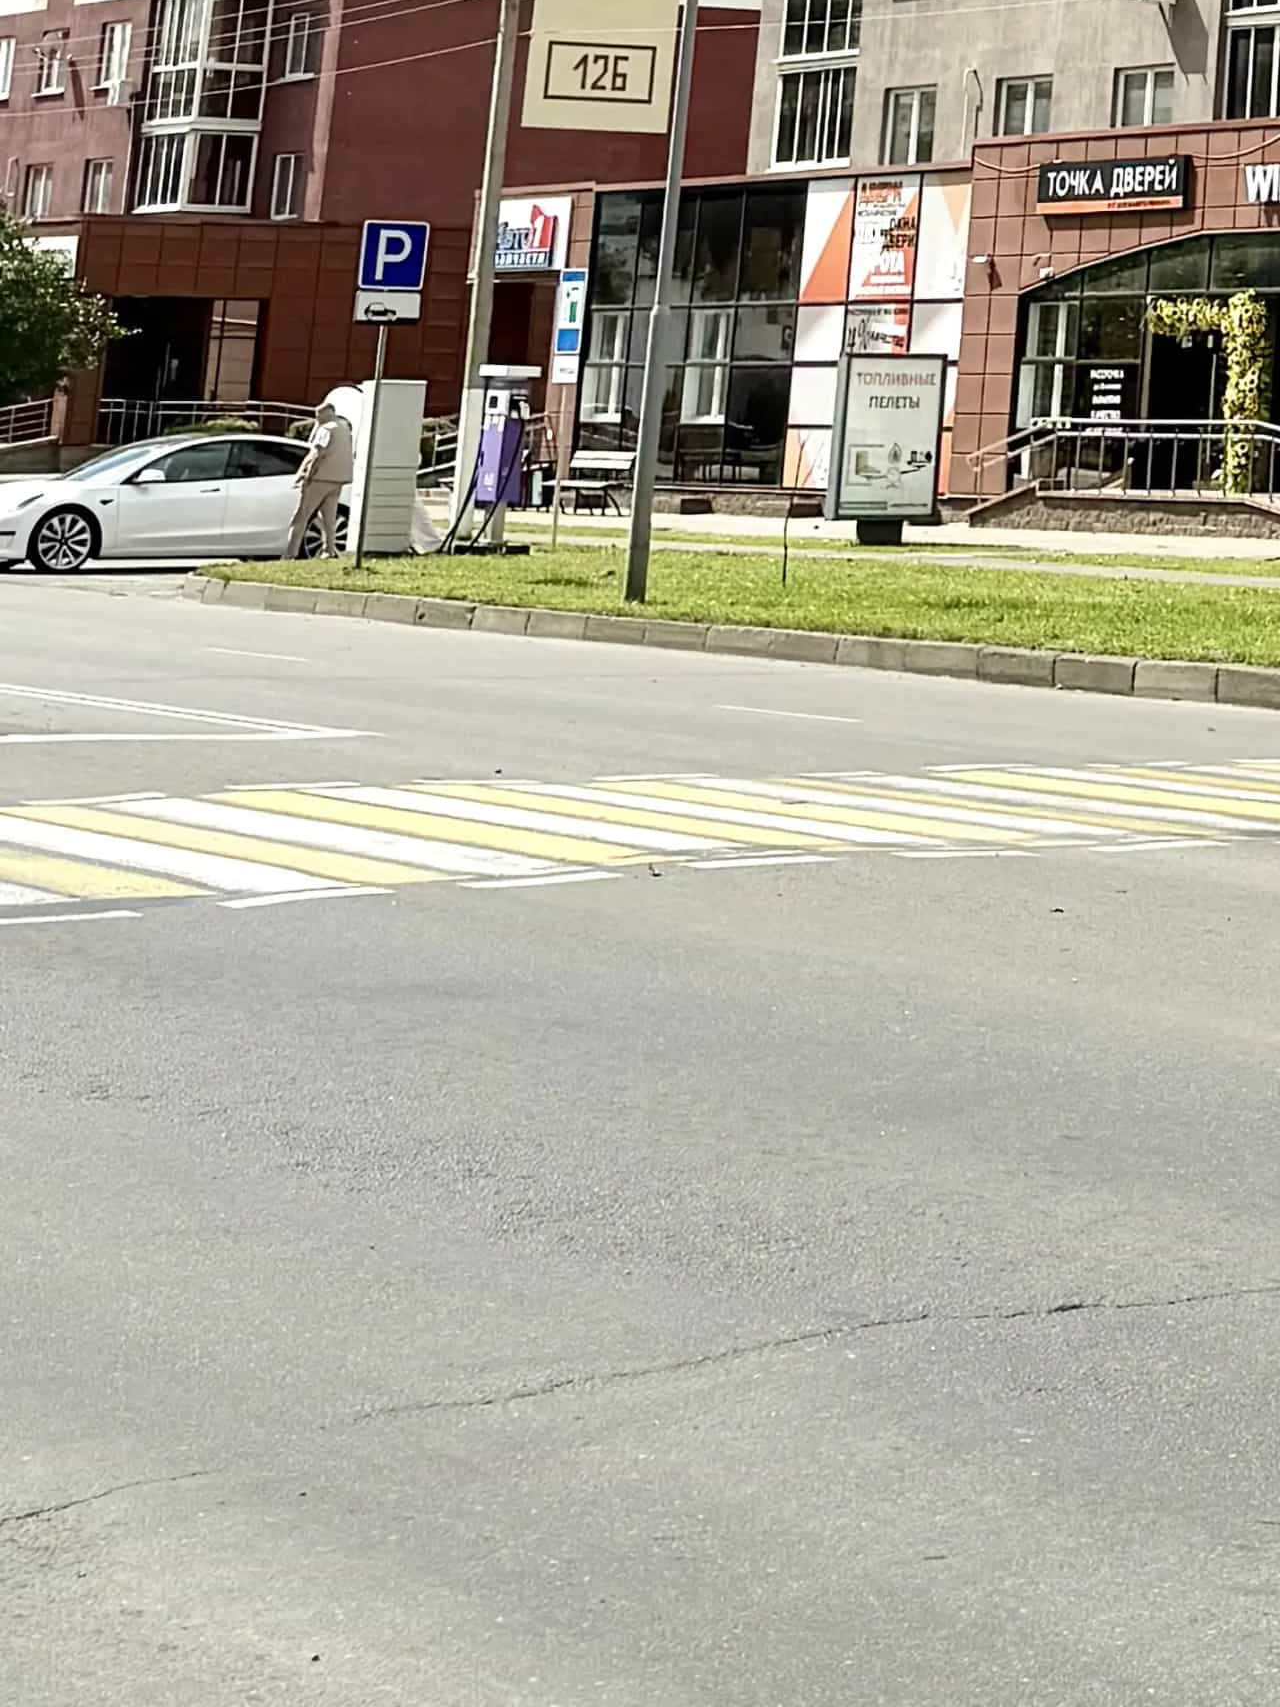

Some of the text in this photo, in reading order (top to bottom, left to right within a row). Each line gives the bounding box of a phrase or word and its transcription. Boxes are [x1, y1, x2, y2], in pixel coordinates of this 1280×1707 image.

[1047, 158, 1178, 198] ТОЧКА ДВЕРЕЙ
[374, 228, 413, 281] P
[856, 371, 937, 387] ТОПЛИВНЫЕ
[868, 395, 921, 409] ПЕЛЕТЫ
